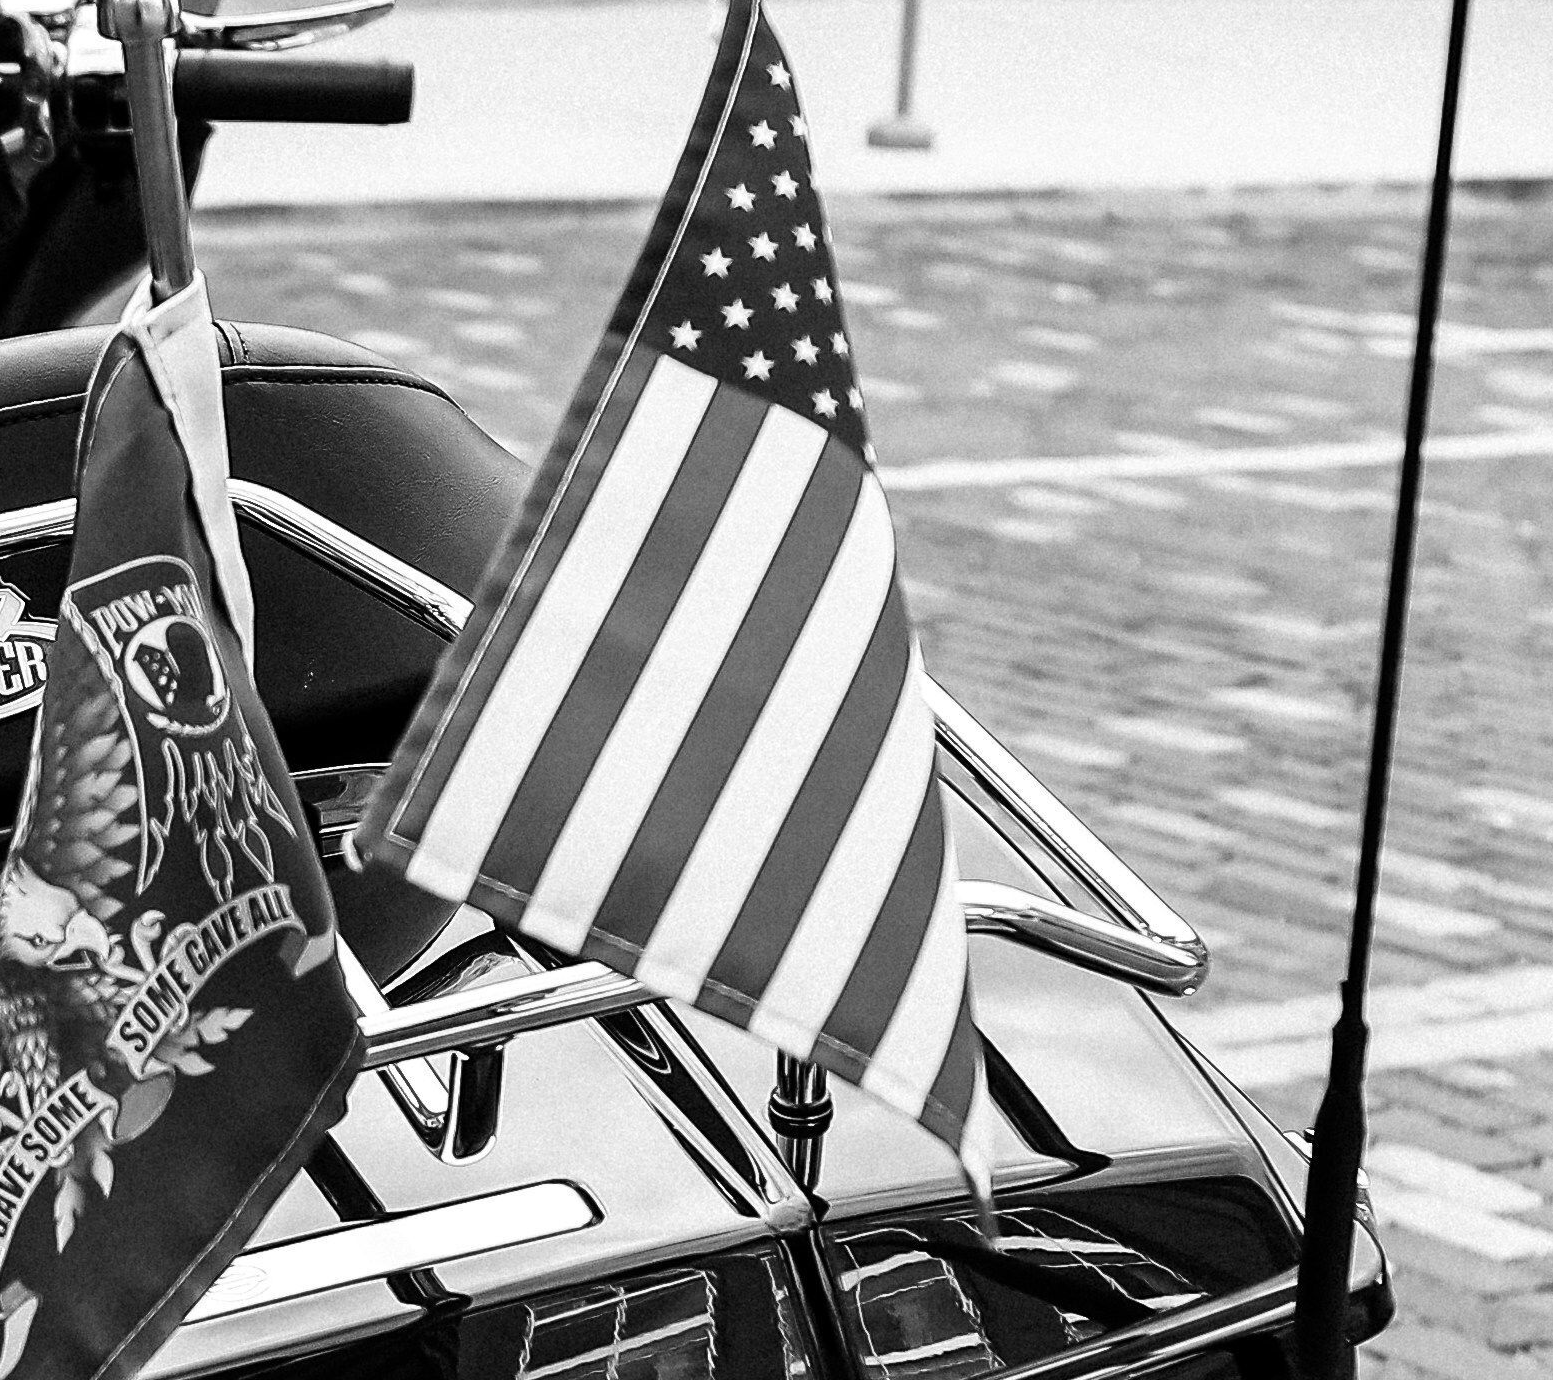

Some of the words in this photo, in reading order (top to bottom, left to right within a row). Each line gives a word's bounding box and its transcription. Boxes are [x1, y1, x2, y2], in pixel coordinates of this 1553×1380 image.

[88, 589, 158, 661] POW
[119, 958, 193, 1054] SOME
[184, 904, 248, 976] GAVE
[247, 888, 293, 932] ALL
[20, 1081, 98, 1163] SOME
